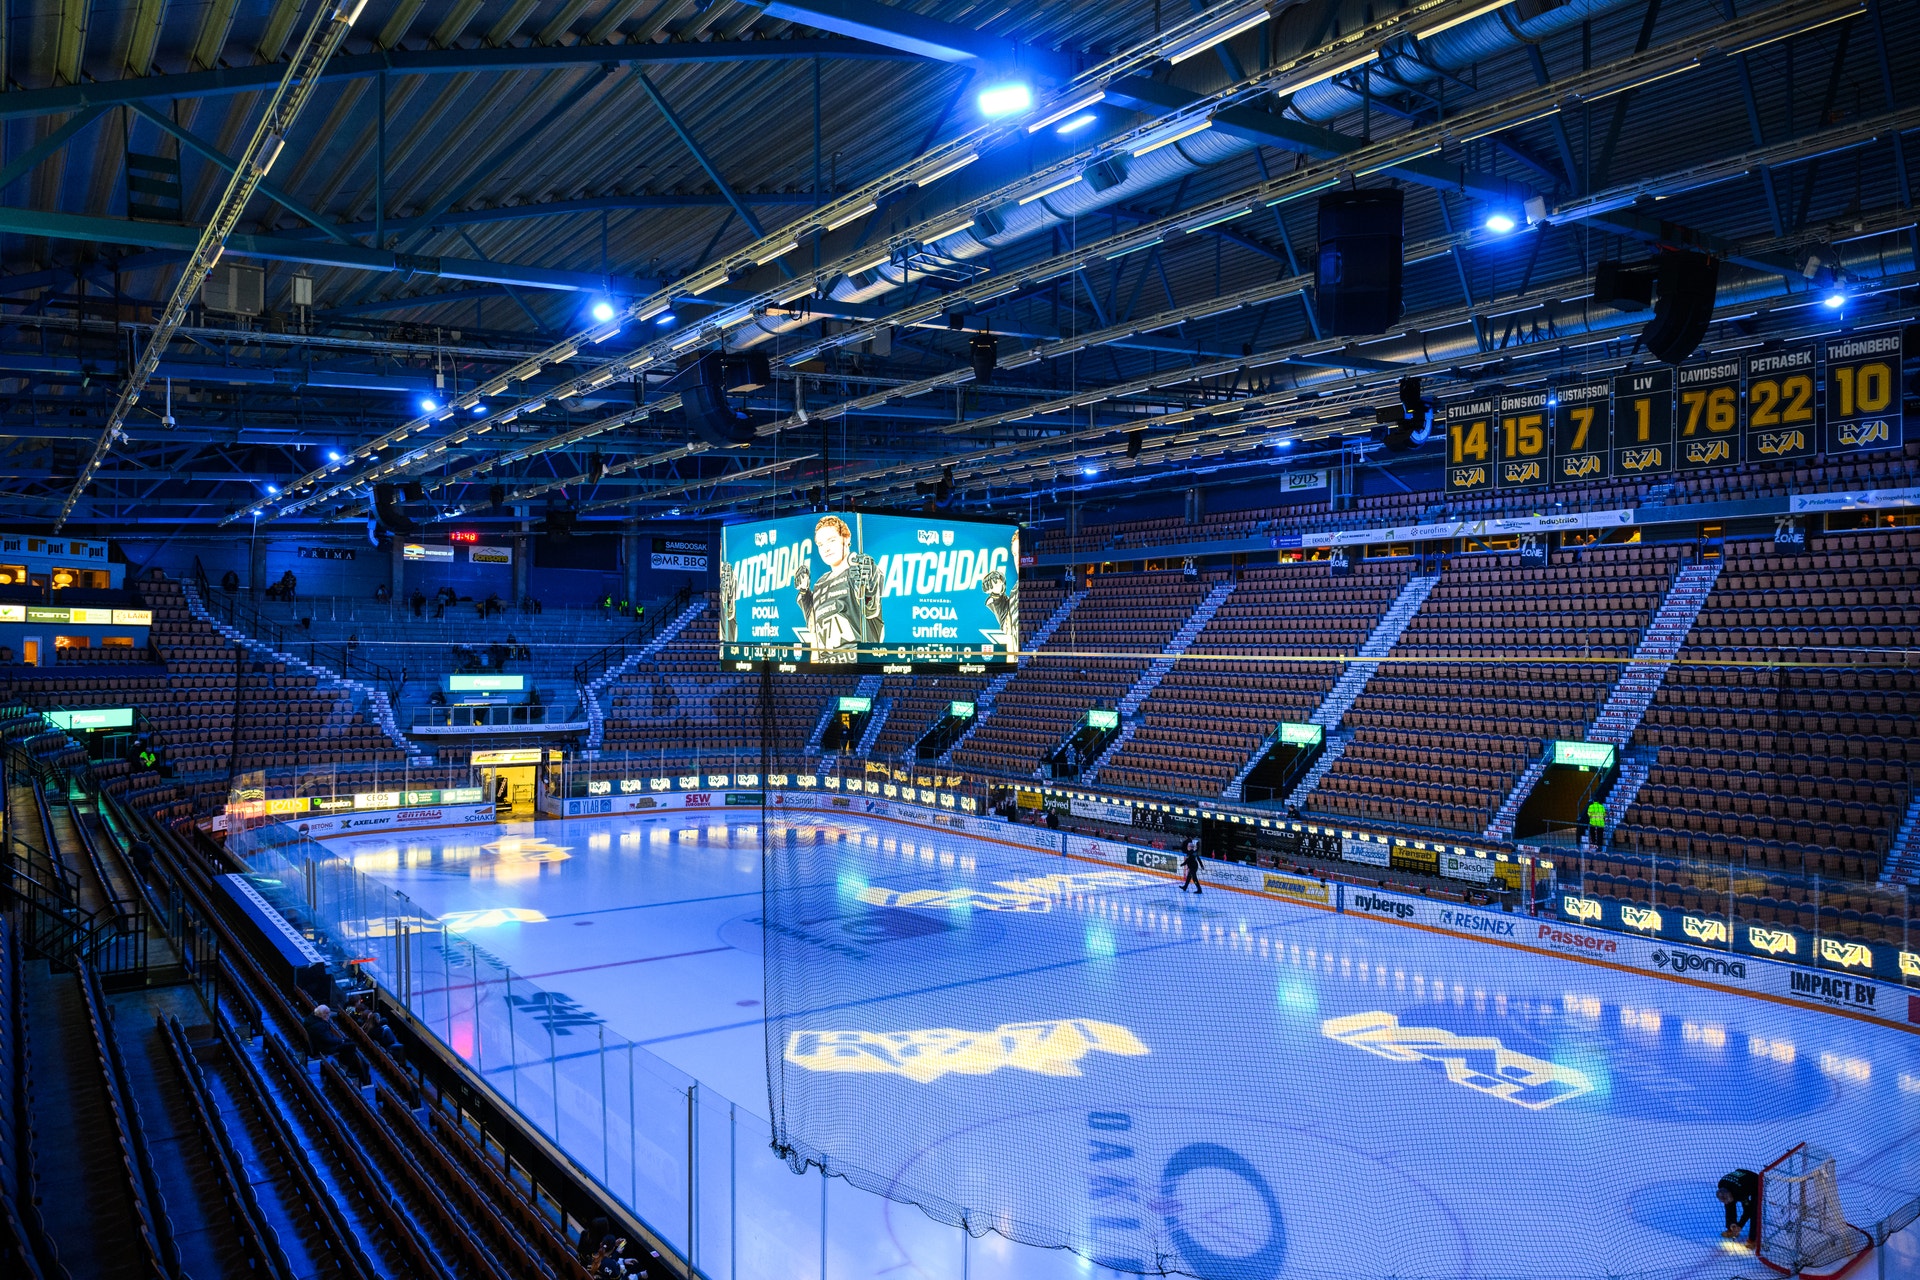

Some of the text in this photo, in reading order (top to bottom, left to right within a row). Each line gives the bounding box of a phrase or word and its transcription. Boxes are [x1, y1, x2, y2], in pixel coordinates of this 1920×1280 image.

[1828, 336, 1899, 359] THÖRNBERG
[1751, 351, 1812, 372] PETRASEK
[1680, 363, 1738, 383] DAVIDSSON
[1558, 384, 1608, 402] GUSTAFSSON
[1634, 377, 1652, 390] LIV
[1836, 362, 1891, 416] 10
[1449, 402, 1491, 418] STILLMAN
[1501, 394, 1546, 410] ÖRNSKOG
[1682, 386, 1736, 436] 76
[1750, 375, 1813, 427] 22
[1570, 407, 1594, 450] 7
[1635, 398, 1650, 442] 1
[1450, 421, 1488, 463] 14
[1503, 414, 1543, 458] 15
[1758, 430, 1804, 455] HV71
[1838, 420, 1888, 446] HV71
[1622, 448, 1662, 470] HV71
[1686, 440, 1729, 464] HV71
[1505, 462, 1540, 483] HV71
[1564, 456, 1600, 477] HV71
[1290, 474, 1318, 485] RYDS
[1453, 468, 1484, 488] HV71
[1774, 519, 1794, 534] 71
[1521, 535, 1536, 550] 71
[1774, 533, 1804, 544] ZONE
[473, 553, 508, 562] Jonsons
[662, 556, 706, 568] MR. BBQ
[1332, 549, 1343, 560] 71
[1521, 548, 1543, 557] ZONE
[752, 606, 779, 619] POOLIA
[912, 606, 958, 620] POOLIA
[752, 622, 779, 636] uniflex
[912, 623, 958, 638] uniflex
[271, 798, 302, 810] RYDS
[582, 800, 600, 814] YLAB
[686, 794, 712, 802] SEW
[1044, 796, 1069, 810] Sydved
[354, 818, 390, 826] AXELENT
[1260, 828, 1294, 838] TOSITO
[1460, 861, 1486, 874] PacsOn
[1355, 894, 1414, 918] nybergs
[1454, 912, 1516, 936] RESINEX
[1683, 916, 1726, 942] HV71
[1538, 924, 1616, 952] Passera
[1750, 927, 1796, 954] HV71
[1821, 939, 1872, 968] HV71
[1790, 971, 1876, 1005] IMPACT BY
